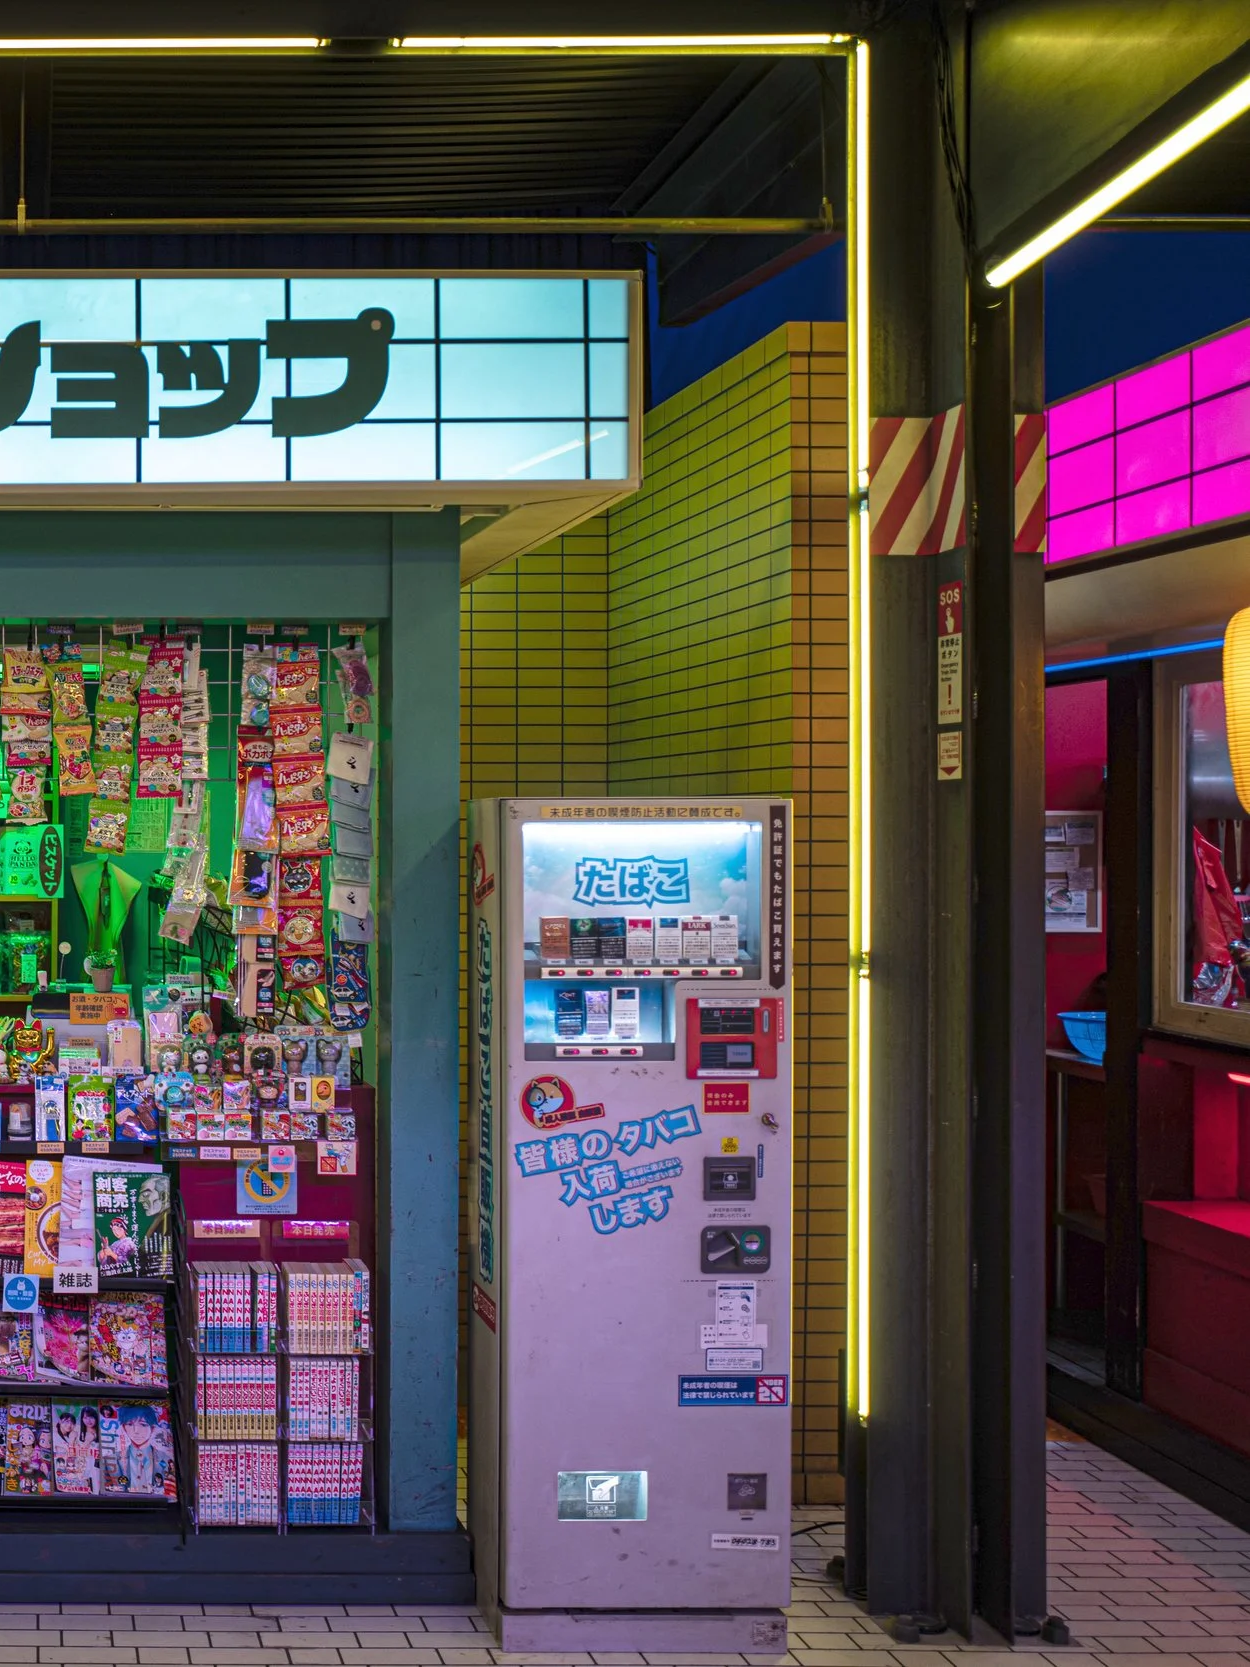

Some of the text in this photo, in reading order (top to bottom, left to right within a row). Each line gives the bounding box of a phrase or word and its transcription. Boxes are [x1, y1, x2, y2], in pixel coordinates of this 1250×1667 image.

[939, 588, 960, 605] SOS
[942, 650, 959, 659] ボタン
[18, 785, 36, 793] からの
[550, 806, 741, 818] 未成年者の喫煙防止活動に賛成です。
[46, 833, 58, 891] ビスケット
[576, 857, 689, 906] たばこ
[773, 818, 783, 974] 免許証でもたばこ買えます
[95, 1177, 128, 1191] 剣客
[562, 1164, 617, 1203] 入荷
[96, 1193, 129, 1208] 商売
[592, 1187, 672, 1232] します
[292, 1225, 335, 1236] 本日発売
[59, 1272, 93, 1288] 雑誌
[682, 1381, 738, 1389] 未成年者の喫煙は
[682, 1391, 755, 1399] 法律で禁じられています
